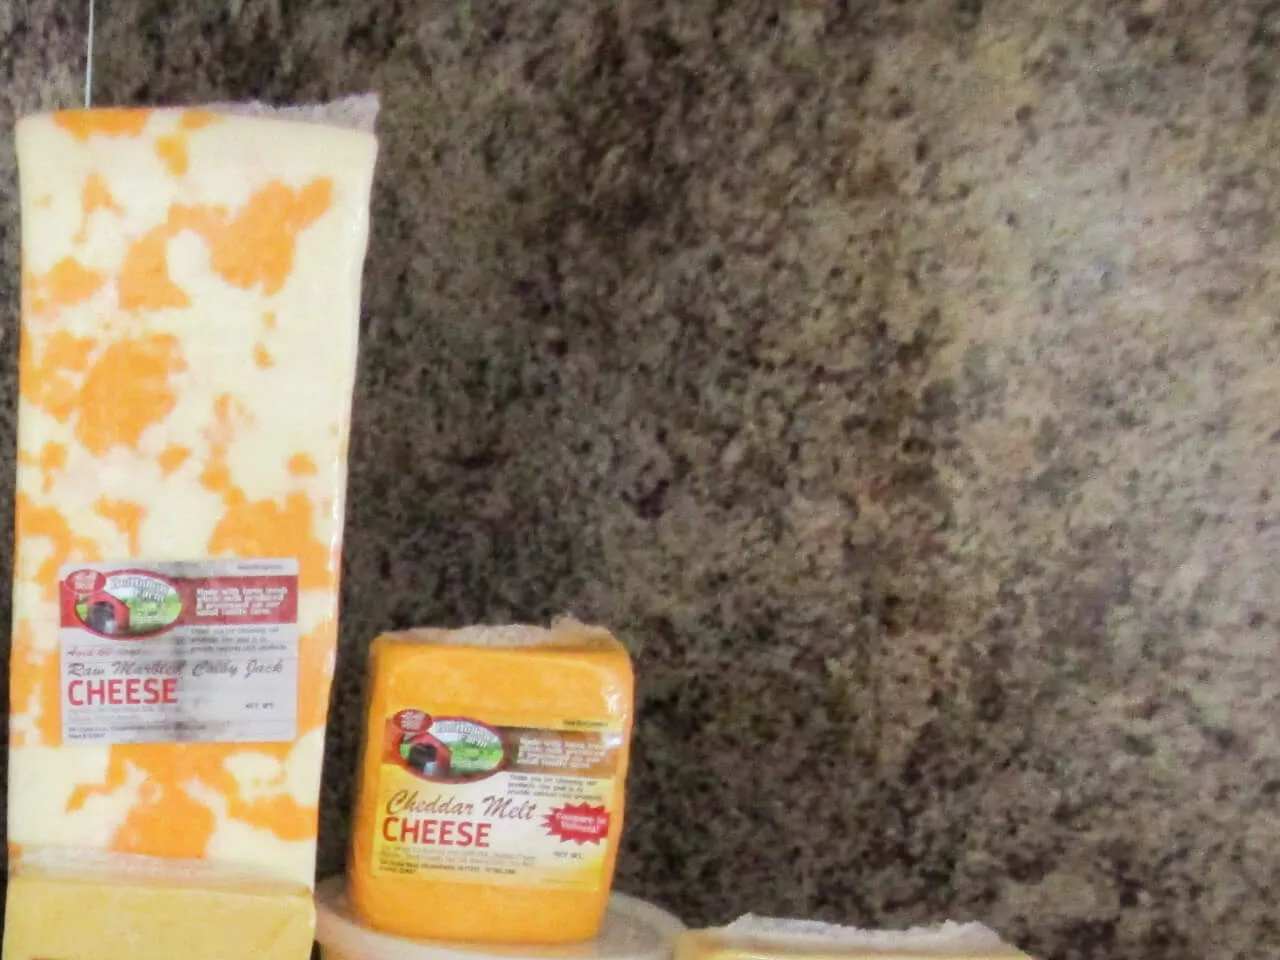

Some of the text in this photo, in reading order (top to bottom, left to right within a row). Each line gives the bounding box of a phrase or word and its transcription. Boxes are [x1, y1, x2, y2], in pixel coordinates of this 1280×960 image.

[67, 662, 105, 677] Raw
[191, 658, 239, 677] Colby
[243, 658, 284, 679] Jack
[67, 677, 179, 706] CHEESE
[385, 789, 474, 816] Cheddar
[481, 794, 537, 821] Melt
[382, 816, 493, 848] CHEESE
